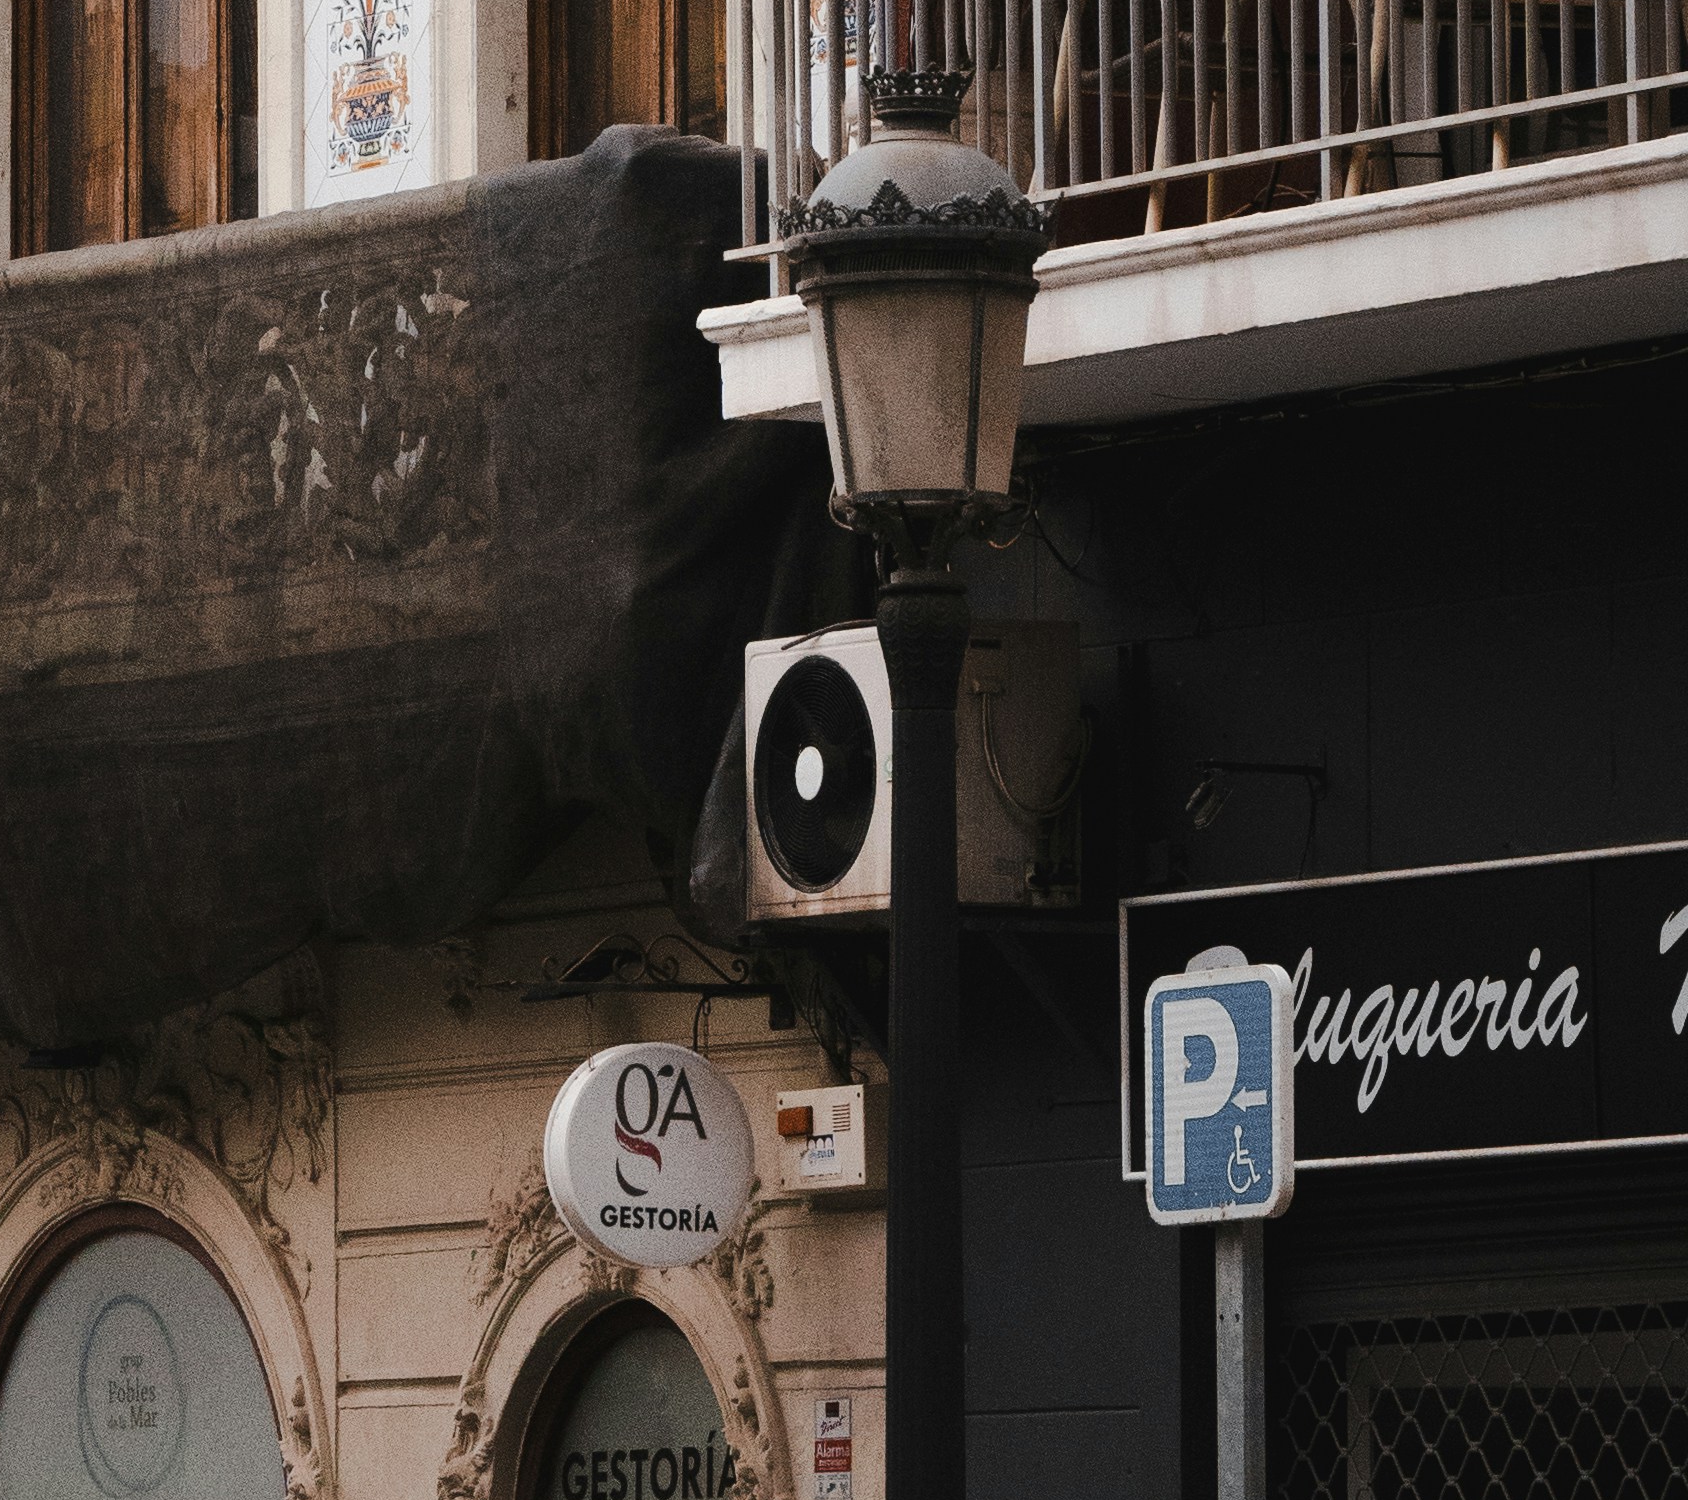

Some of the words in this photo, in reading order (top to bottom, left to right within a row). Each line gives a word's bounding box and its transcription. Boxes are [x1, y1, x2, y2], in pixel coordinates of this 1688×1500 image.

[1187, 945, 1587, 1113] luqueria
[1162, 997, 1239, 1186] P
[600, 1204, 719, 1233] GESTORÍA
[130, 1405, 159, 1429] Mar
